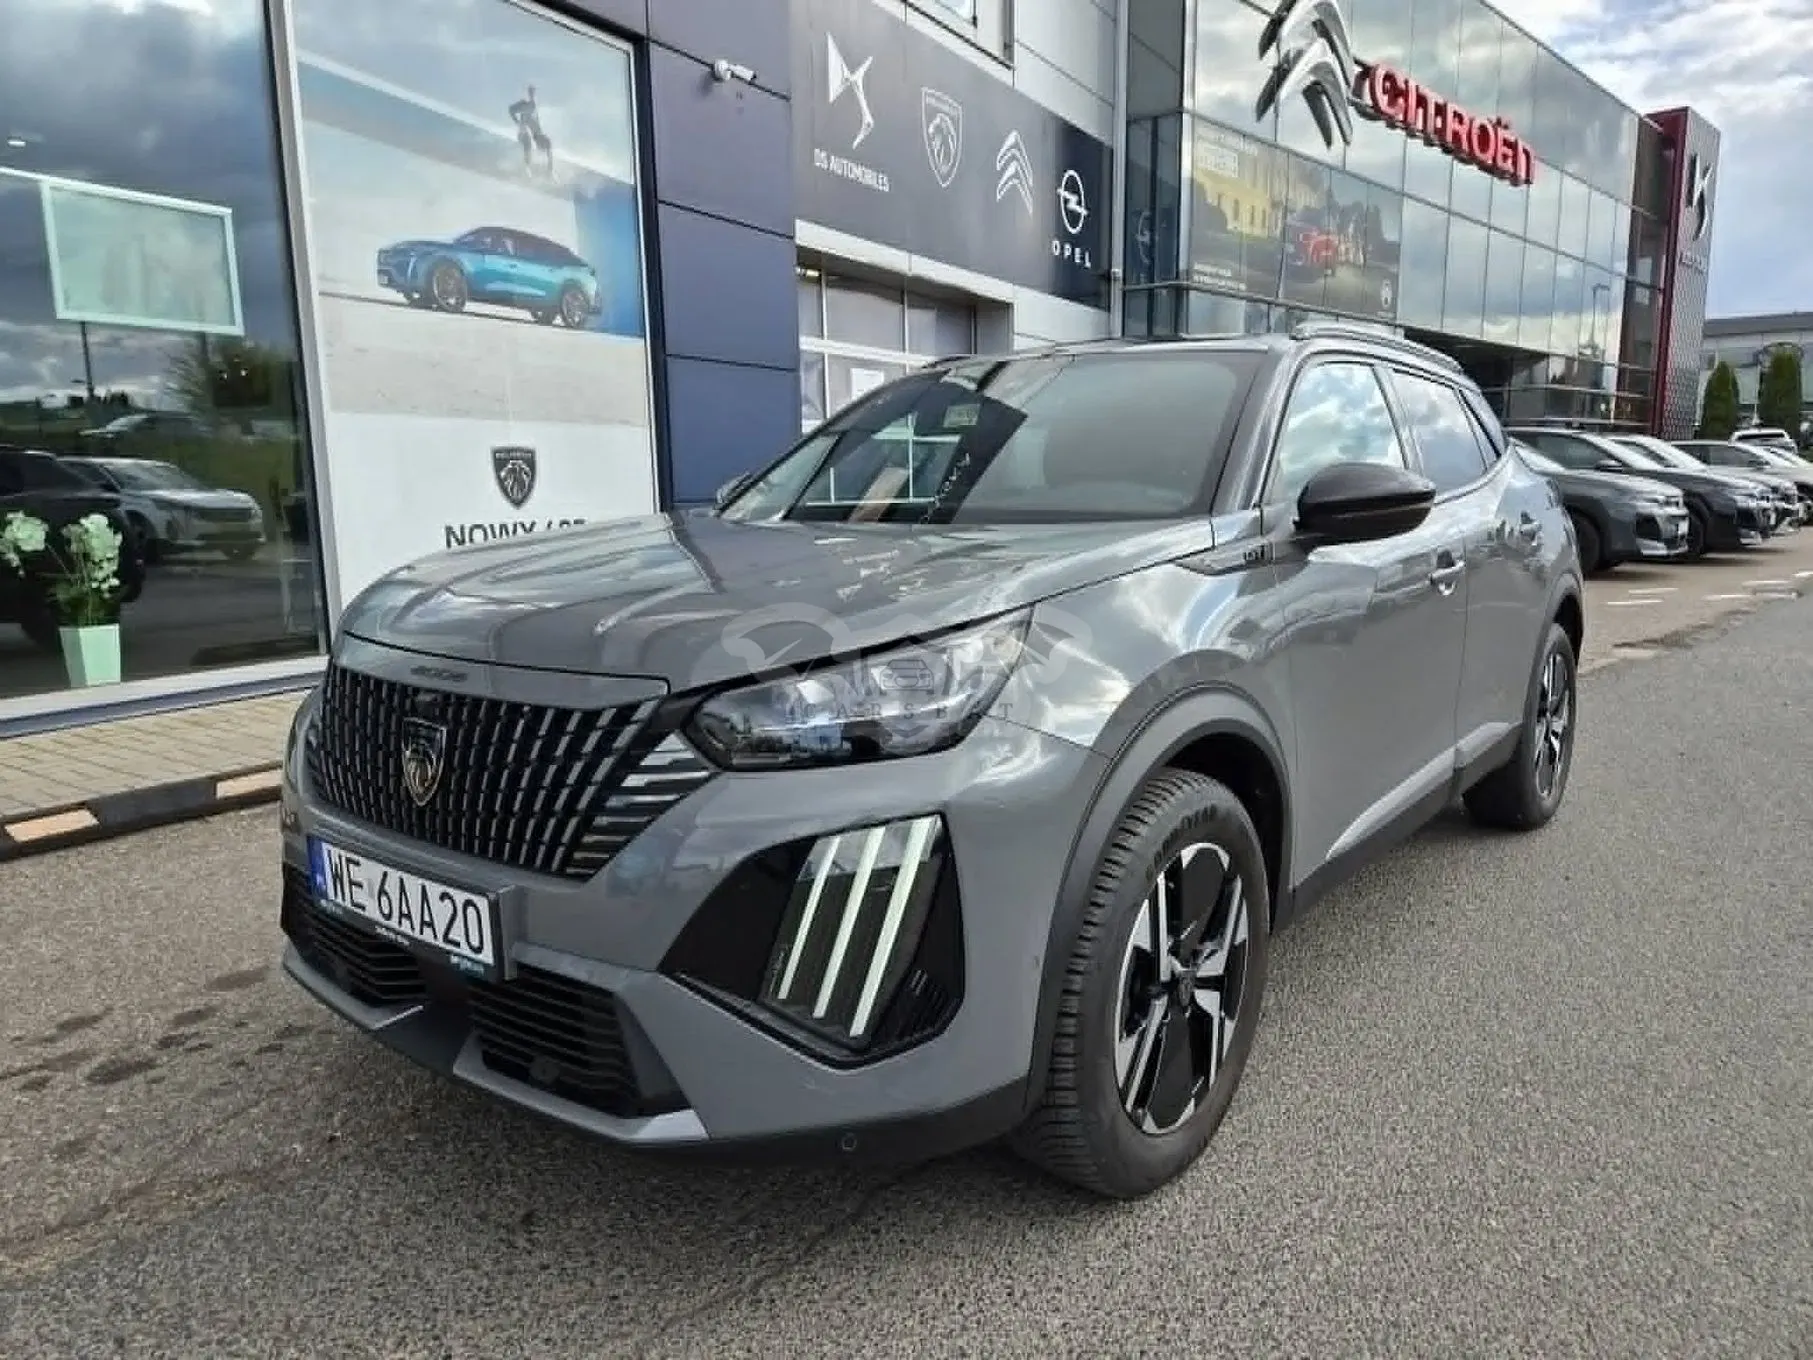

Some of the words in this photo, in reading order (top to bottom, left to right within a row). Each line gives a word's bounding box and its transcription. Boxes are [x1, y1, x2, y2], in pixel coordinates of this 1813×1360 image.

[1051, 239, 1092, 268] OPEL
[327, 848, 367, 911] WE
[376, 870, 484, 954] 6AA20
